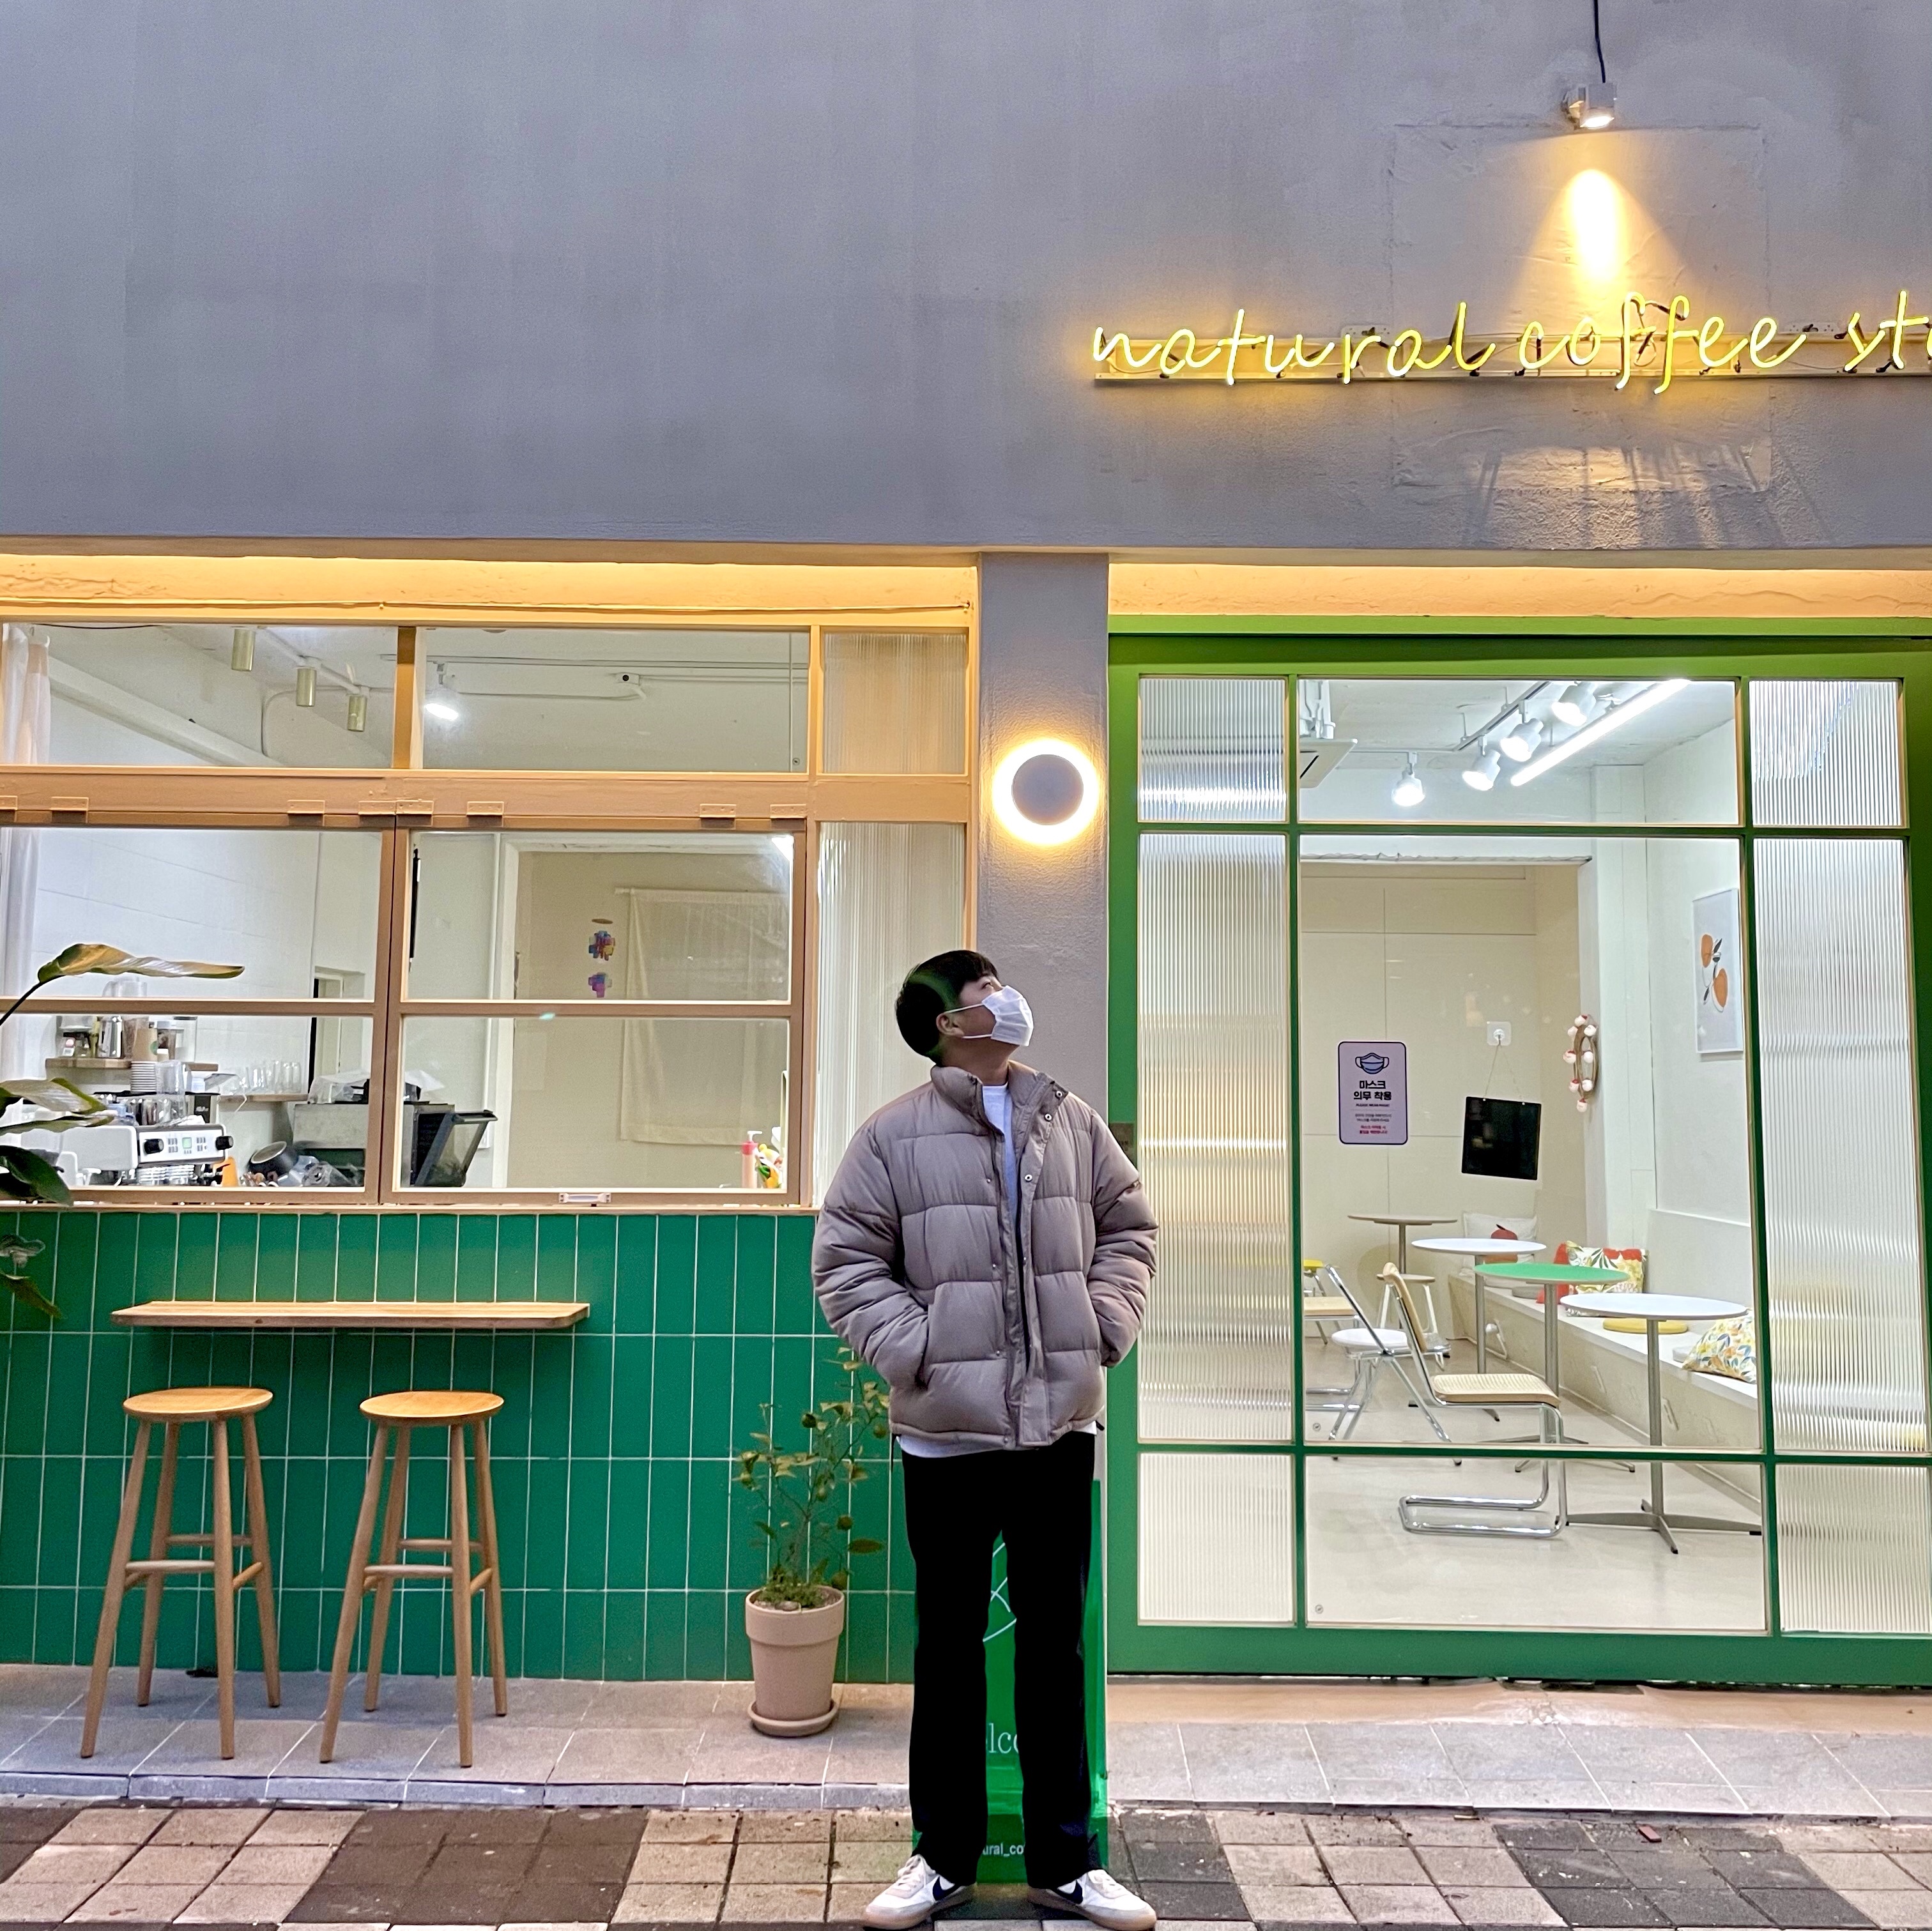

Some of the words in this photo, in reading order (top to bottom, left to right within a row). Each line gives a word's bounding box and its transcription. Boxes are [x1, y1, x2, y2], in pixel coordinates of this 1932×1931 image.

[1092, 302, 1496, 385] natural
[1518, 291, 1807, 395] coffee
[1844, 290, 1932, 372] st
[1359, 1080, 1386, 1089] 마스크
[1353, 1091, 1372, 1101] 의무
[1374, 1091, 1392, 1101] 착용
